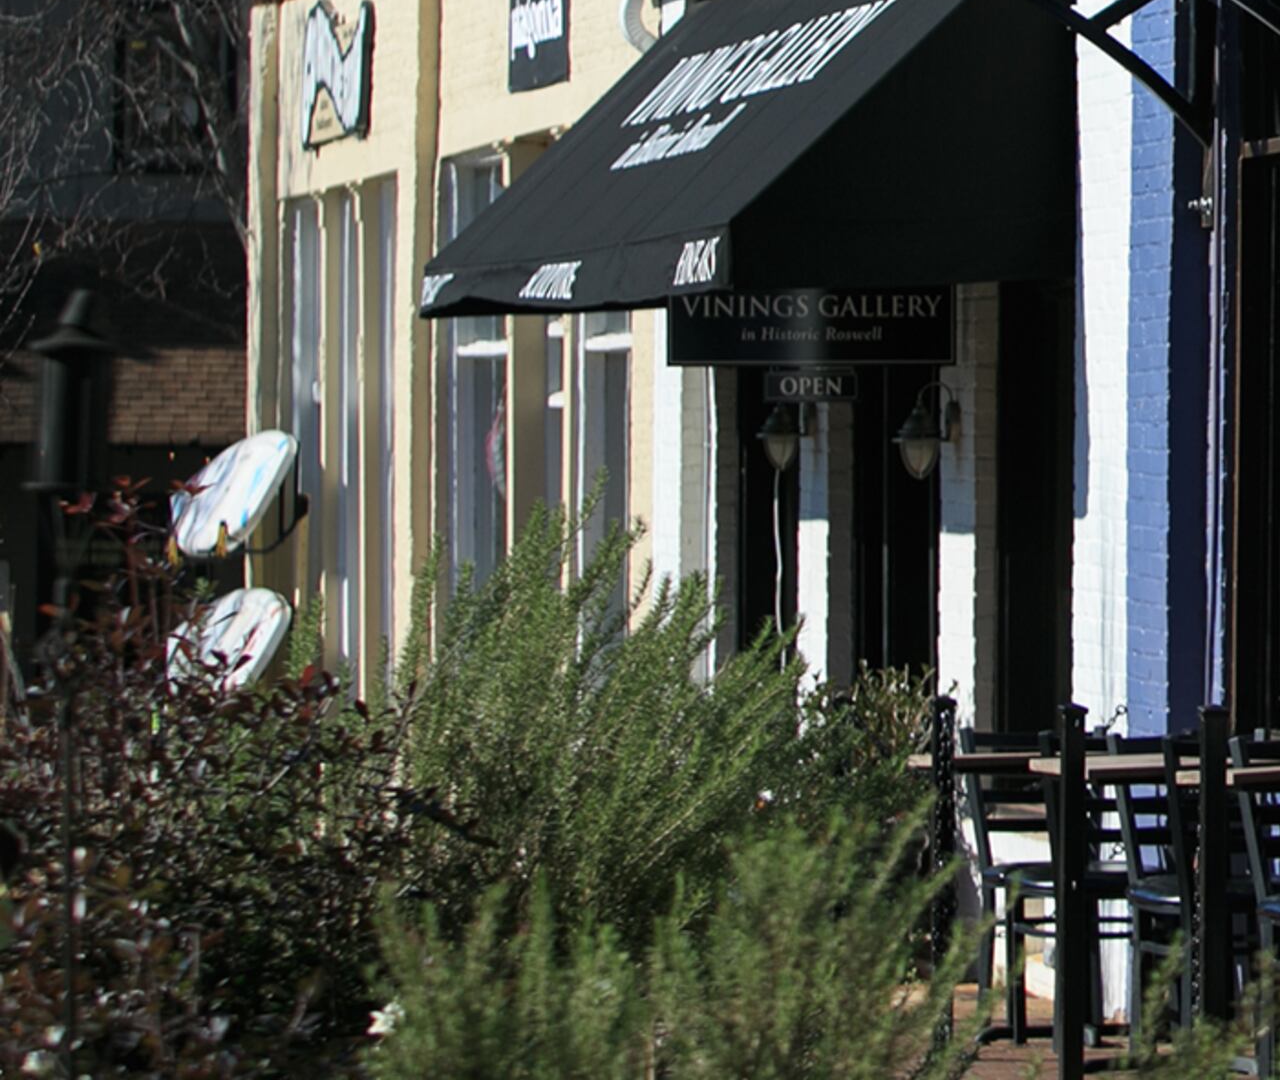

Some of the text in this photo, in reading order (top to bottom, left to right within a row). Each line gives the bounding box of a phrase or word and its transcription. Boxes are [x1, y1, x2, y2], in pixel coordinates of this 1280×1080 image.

[620, 29, 779, 127] VININGS
[682, 294, 942, 318] VININGS GALLERY
[740, 326, 883, 342] in Historic Roswell
[779, 375, 842, 396] OPEN
